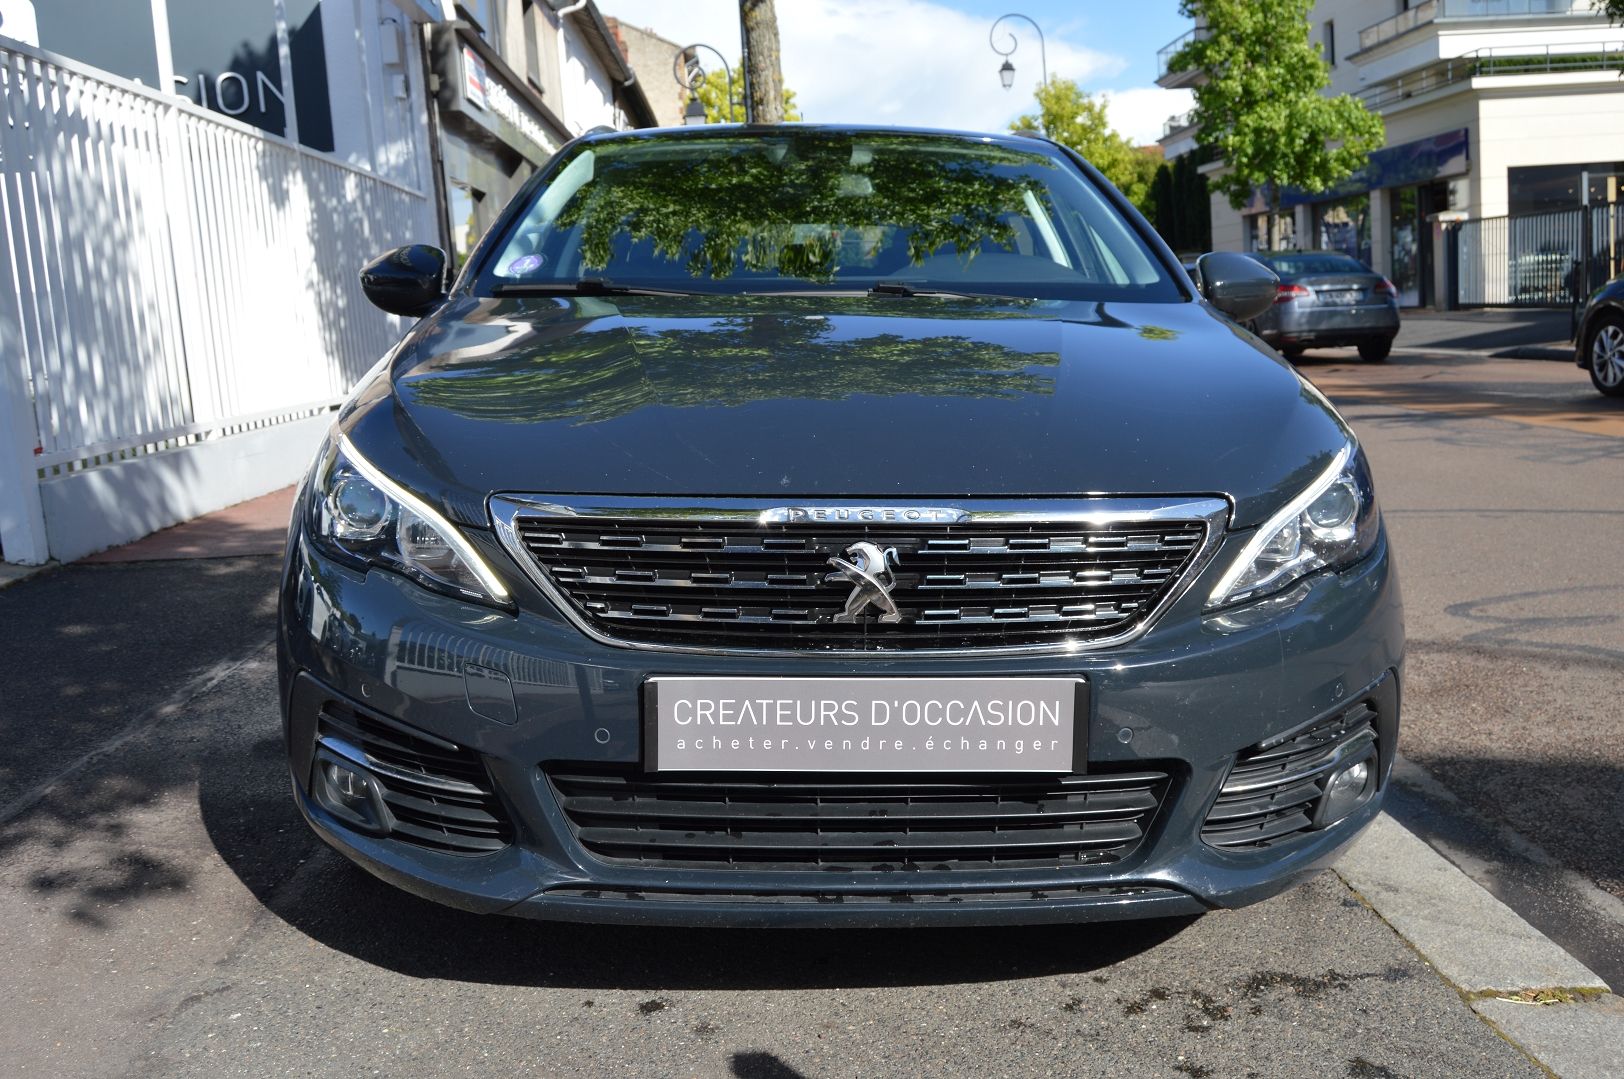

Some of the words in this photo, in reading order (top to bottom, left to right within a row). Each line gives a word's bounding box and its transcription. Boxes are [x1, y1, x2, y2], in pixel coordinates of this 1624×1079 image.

[790, 508, 942, 522] PEUGEOT
[673, 699, 859, 726] CREATEURS
[871, 699, 1060, 726] D'OCCASION
